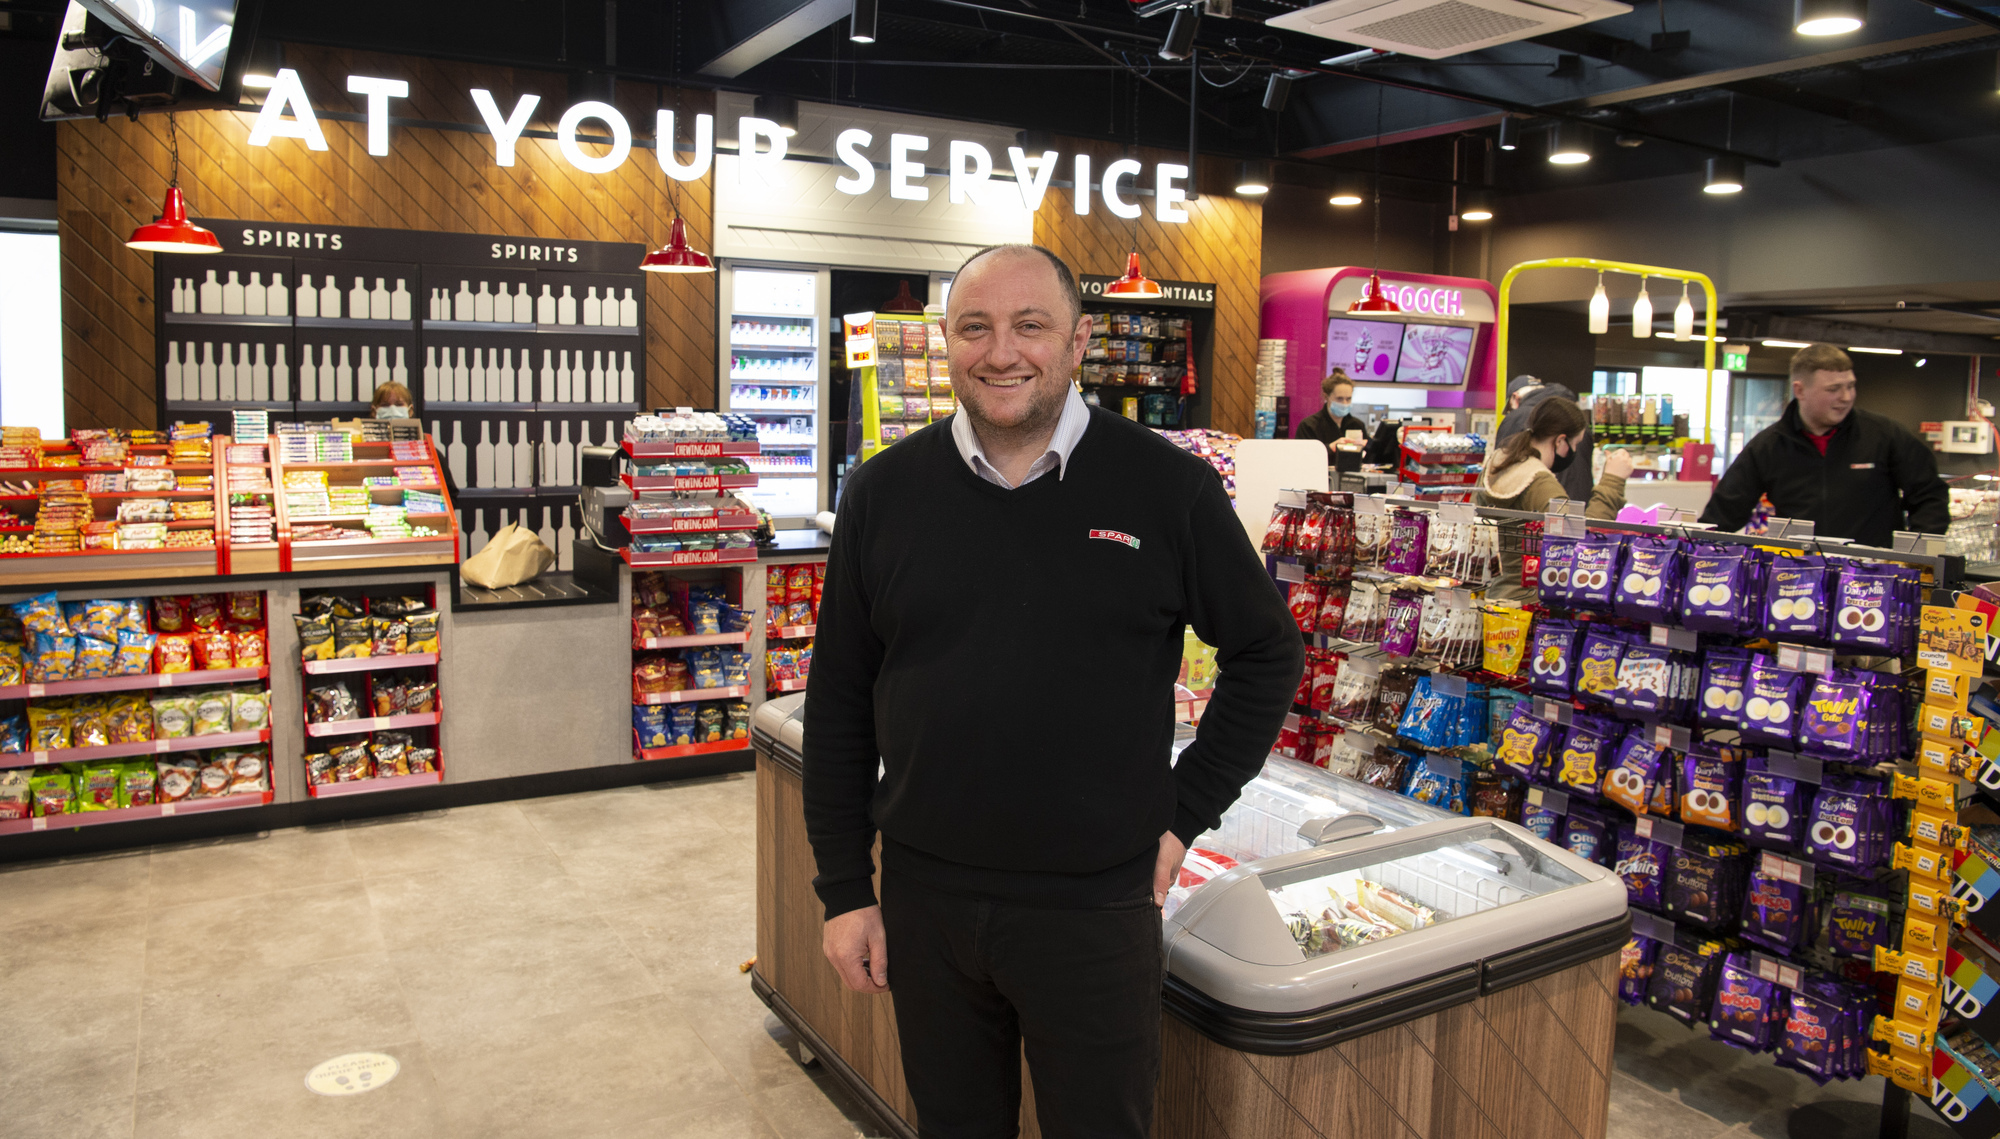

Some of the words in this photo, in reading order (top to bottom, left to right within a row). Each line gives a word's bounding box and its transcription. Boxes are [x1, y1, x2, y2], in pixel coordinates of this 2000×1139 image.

[247, 68, 409, 157] AT
[470, 88, 790, 189] YOUR
[835, 128, 1190, 223] SERVICE
[242, 228, 343, 251] SPIRITS
[491, 243, 579, 263] SPIRITS
[675, 444, 704, 456] CHEWING
[704, 444, 721, 455] GUM
[674, 477, 703, 489] CHEWING
[703, 477, 720, 488] GUM
[673, 519, 702, 530] CHEWING
[702, 518, 718, 529] GUM
[1098, 531, 1131, 545] SPAR
[673, 553, 702, 564] CHEWING
[702, 552, 718, 563] GUM
[1843, 585, 1868, 597] Dairy
[1868, 586, 1885, 595] Milk
[1844, 596, 1882, 607] buttons
[161, 644, 189, 653] KING
[206, 641, 231, 651] KING
[1920, 651, 1946, 660] Crunchy
[1751, 792, 1785, 803] buttons
[1526, 817, 1555, 826] OREO
[1677, 874, 1708, 891] buttons
[1720, 990, 1761, 1010] Wispa
[1786, 1017, 1827, 1039] Wispa
